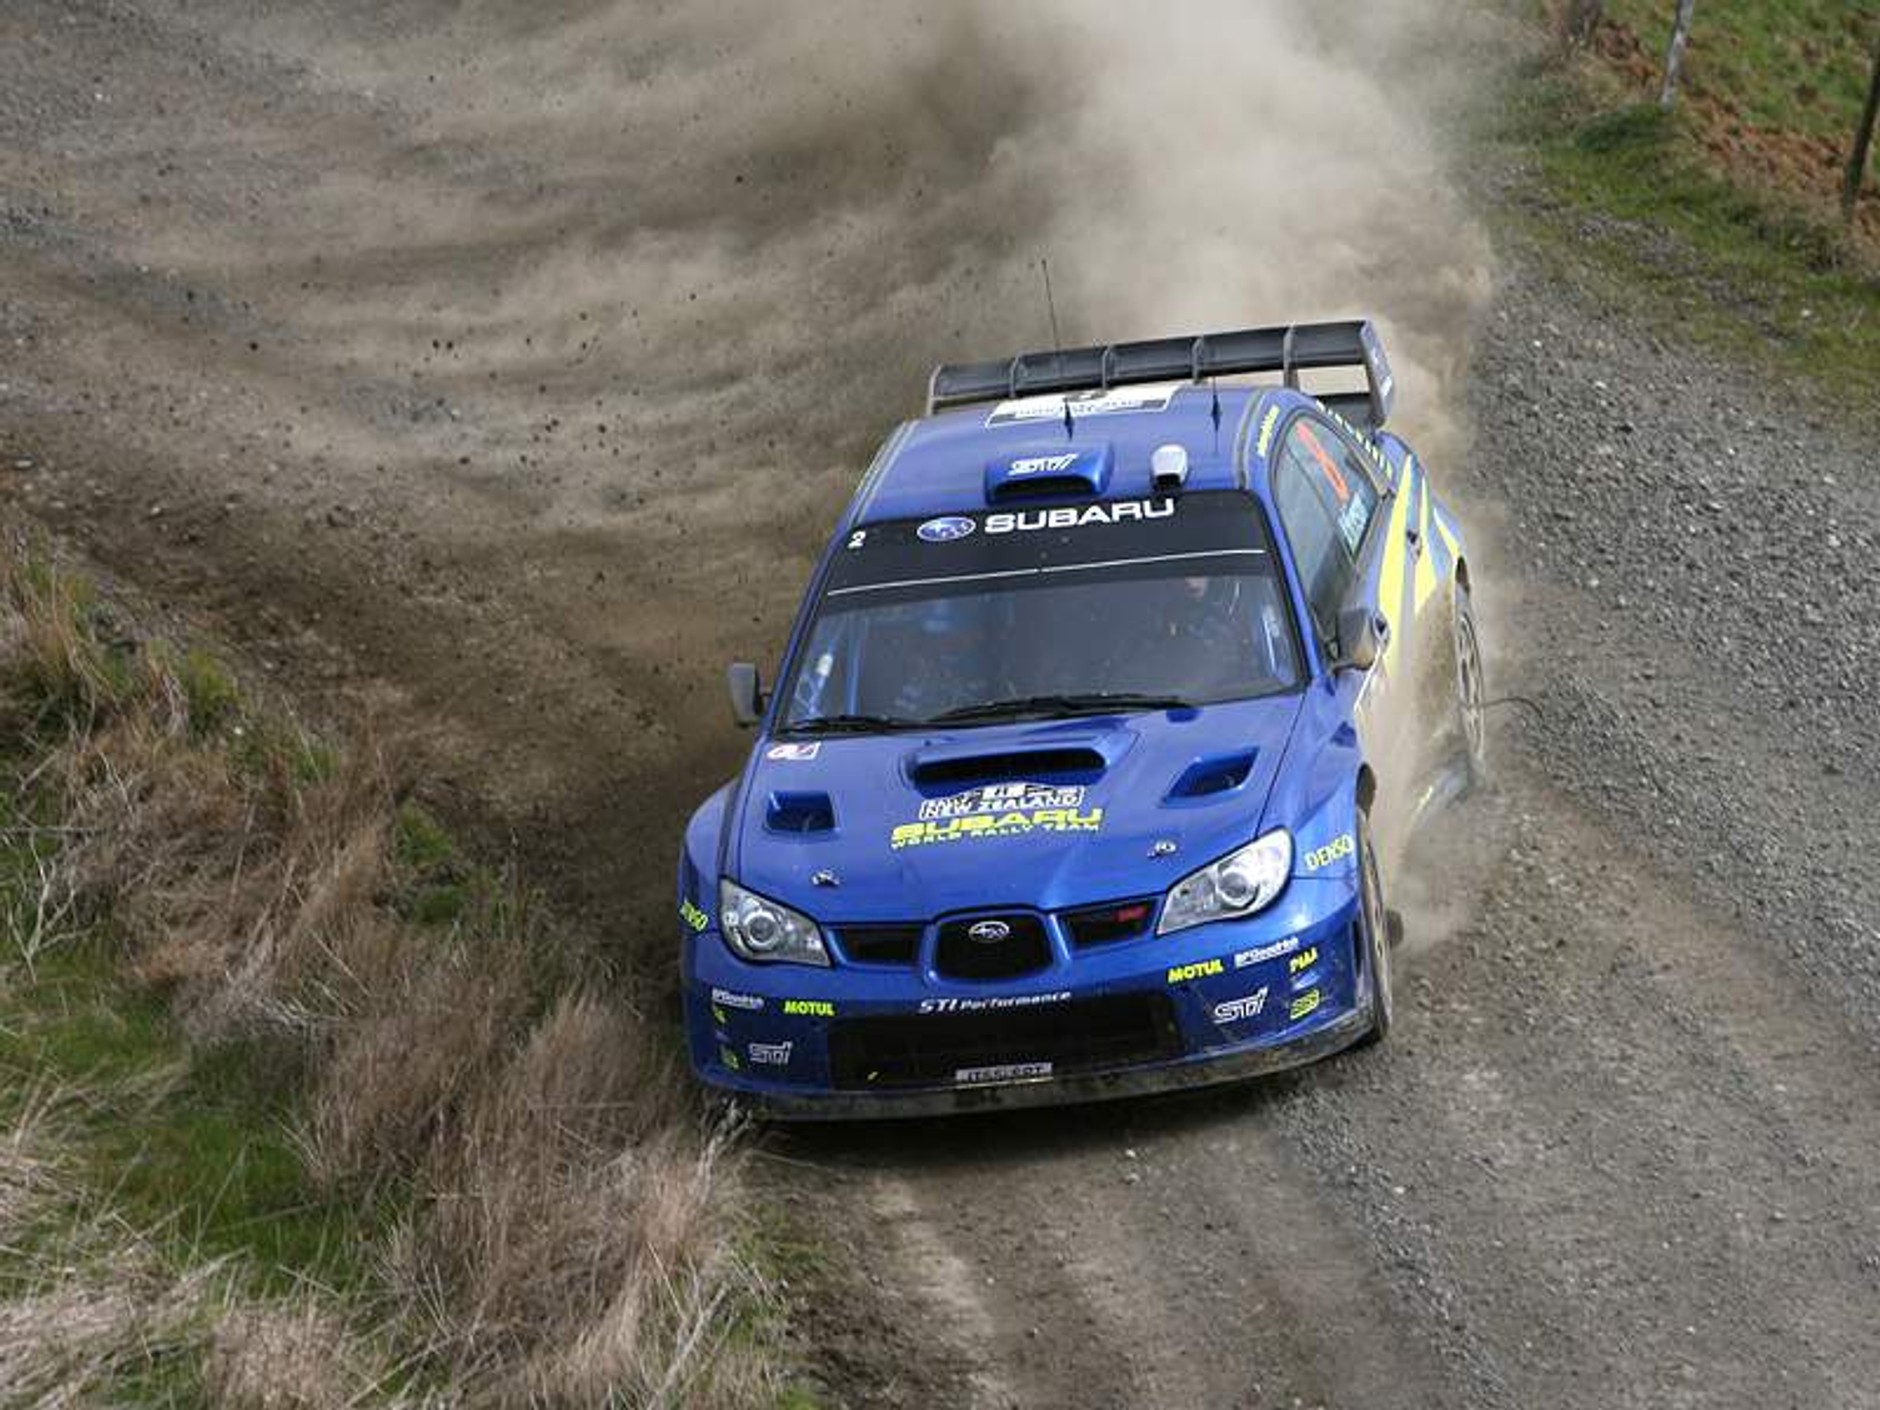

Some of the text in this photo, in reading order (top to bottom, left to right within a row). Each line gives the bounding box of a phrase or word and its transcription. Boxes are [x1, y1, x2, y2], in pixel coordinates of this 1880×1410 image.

[984, 498, 1176, 534] SUBARU
[848, 531, 867, 549] 2
[978, 793, 1079, 812] ZEALAND
[891, 821, 1100, 849] WORLD RALLY TEAM
[892, 808, 1104, 842] SUBARU
[1167, 959, 1224, 983] MOTUL
[784, 1001, 835, 1017] MOTUL
[919, 991, 1072, 1015] STI Performance
